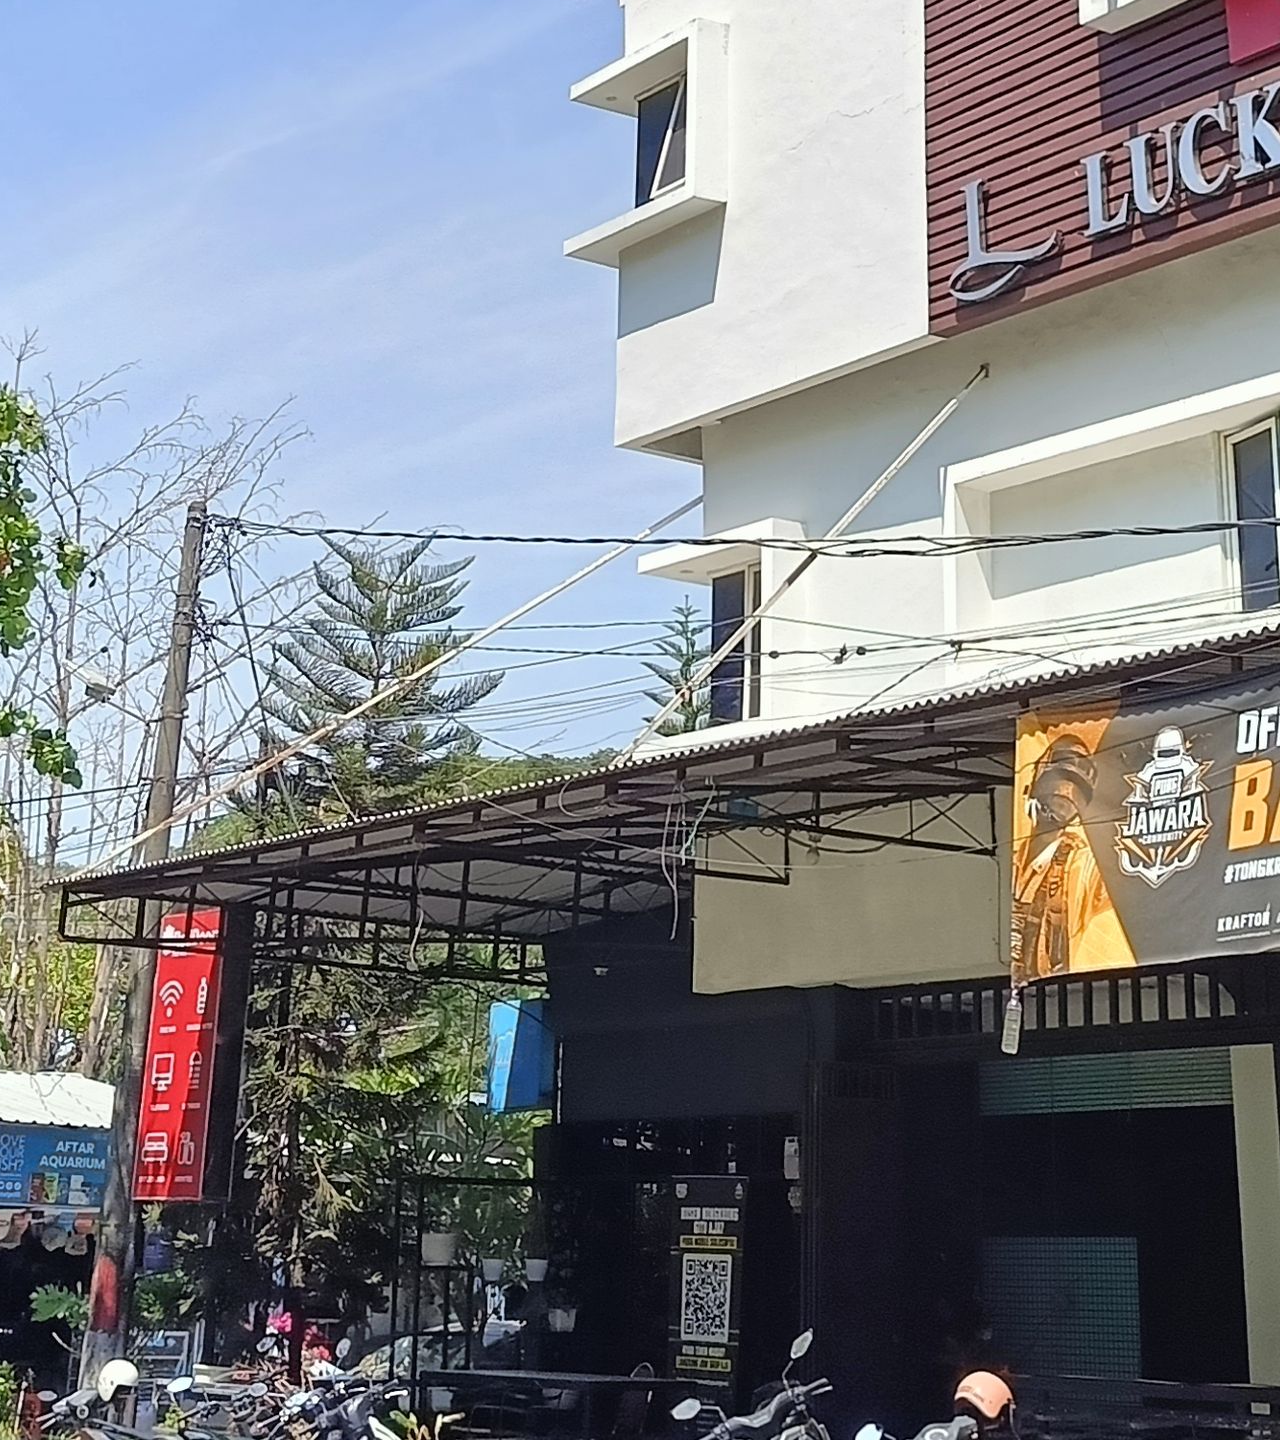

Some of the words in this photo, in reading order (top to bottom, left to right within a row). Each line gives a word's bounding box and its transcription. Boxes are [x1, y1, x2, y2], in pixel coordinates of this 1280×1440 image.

[1121, 796, 1206, 836] JAWARA
[1217, 905, 1271, 933] KRAFTON
[55, 1140, 95, 1155] AFTAR
[39, 1155, 106, 1170] AQUARIUM
